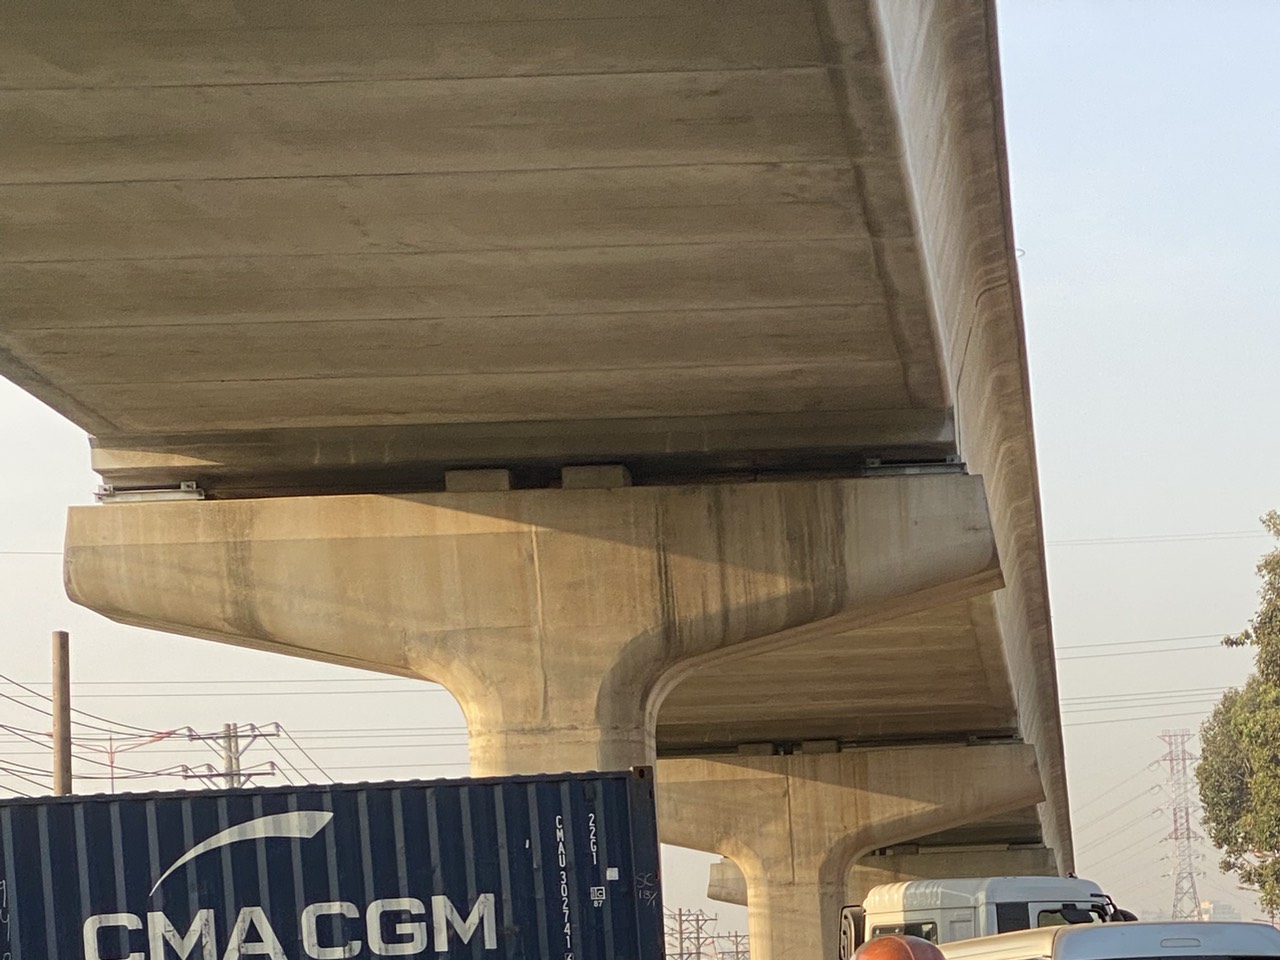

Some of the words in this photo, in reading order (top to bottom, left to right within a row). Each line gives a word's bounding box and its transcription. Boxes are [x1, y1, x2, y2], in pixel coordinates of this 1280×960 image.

[555, 815, 566, 868] CMAU
[588, 813, 597, 865] 22G1
[301, 893, 498, 960] CGM
[559, 871, 571, 949] 302741
